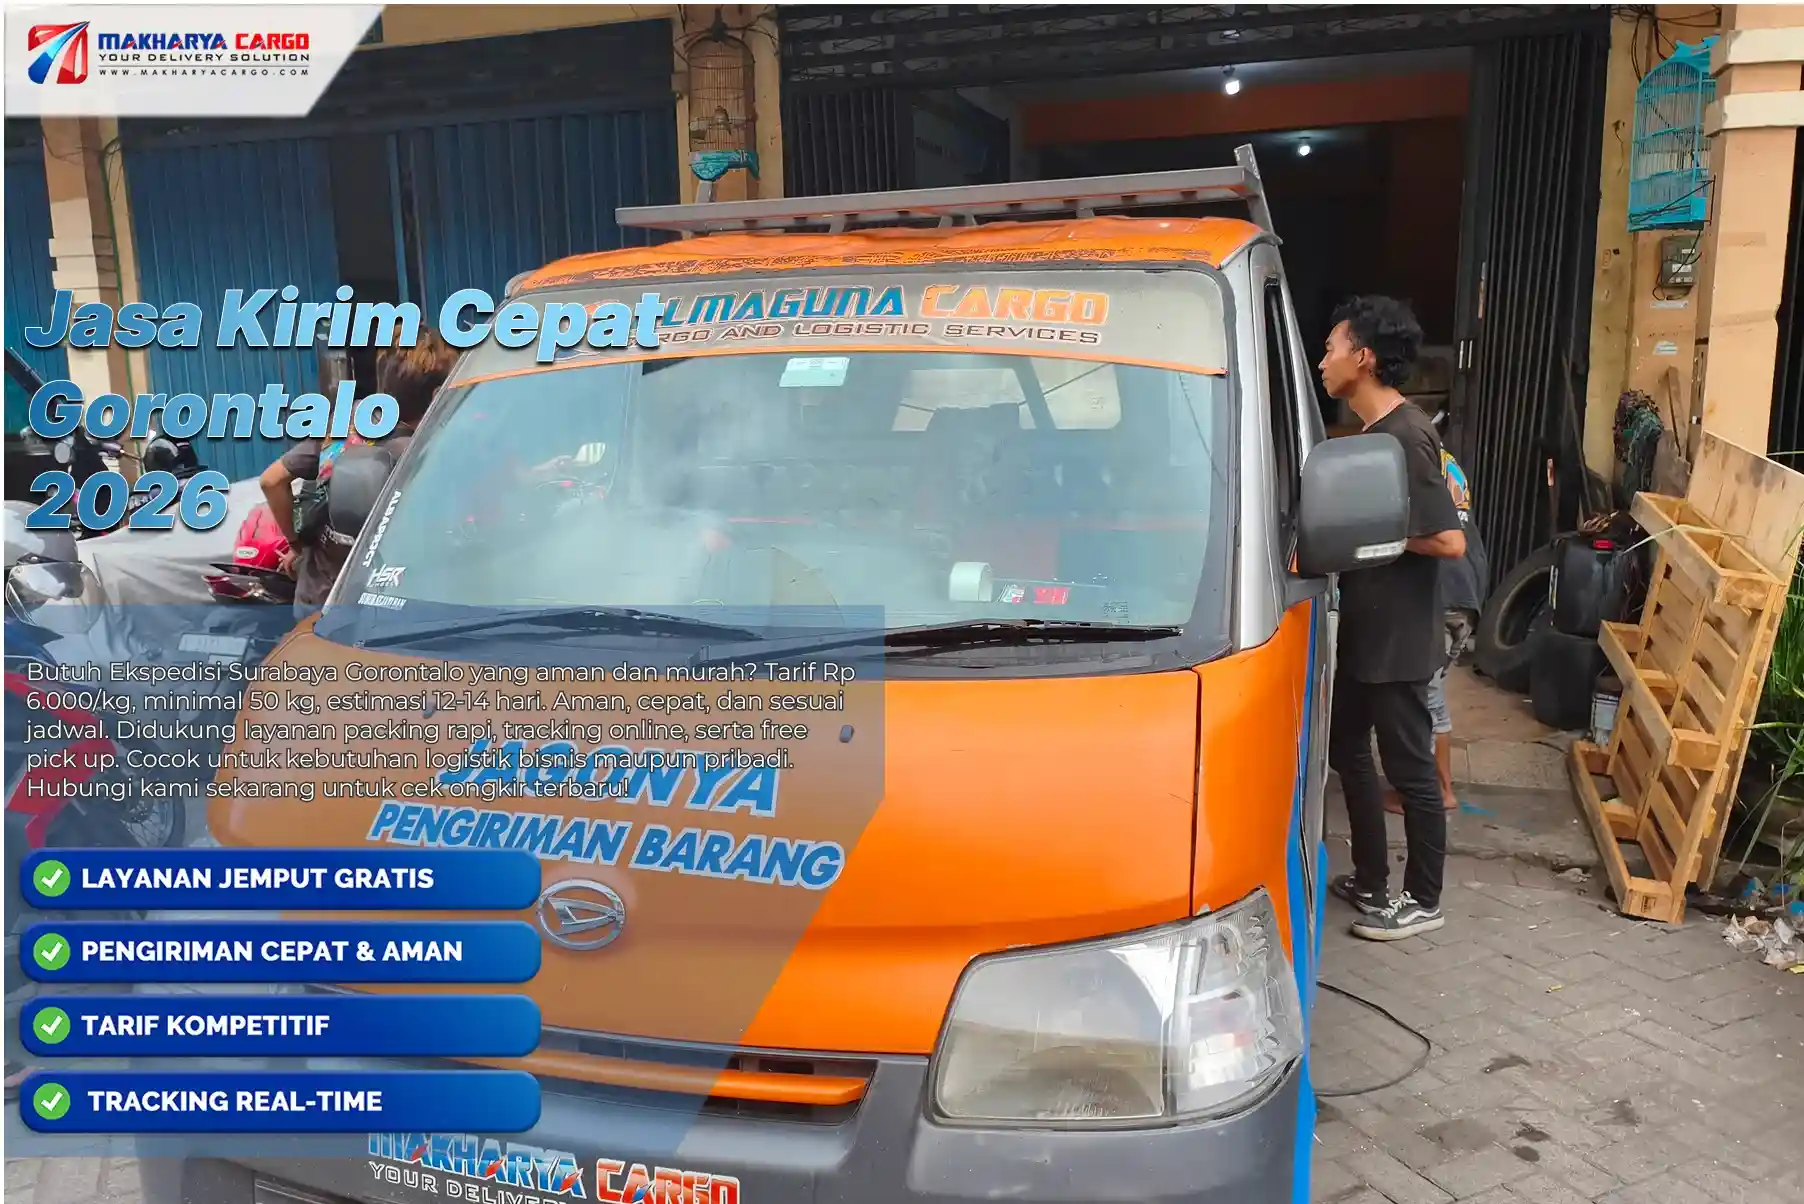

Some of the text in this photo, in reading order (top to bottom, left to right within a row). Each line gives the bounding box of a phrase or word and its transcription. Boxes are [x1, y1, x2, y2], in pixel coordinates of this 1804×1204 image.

[632, 283, 1110, 328] LMAGUNA CARGO
[721, 323, 781, 341] AND
[792, 321, 930, 338] LOGISTIC
[943, 323, 1101, 345] SERVICES
[436, 738, 780, 818] JAGONYA
[366, 800, 845, 890] PENGIRIMAN BARANG
[368, 1161, 439, 1194] YOUR
[596, 1158, 741, 1204] CARGO
